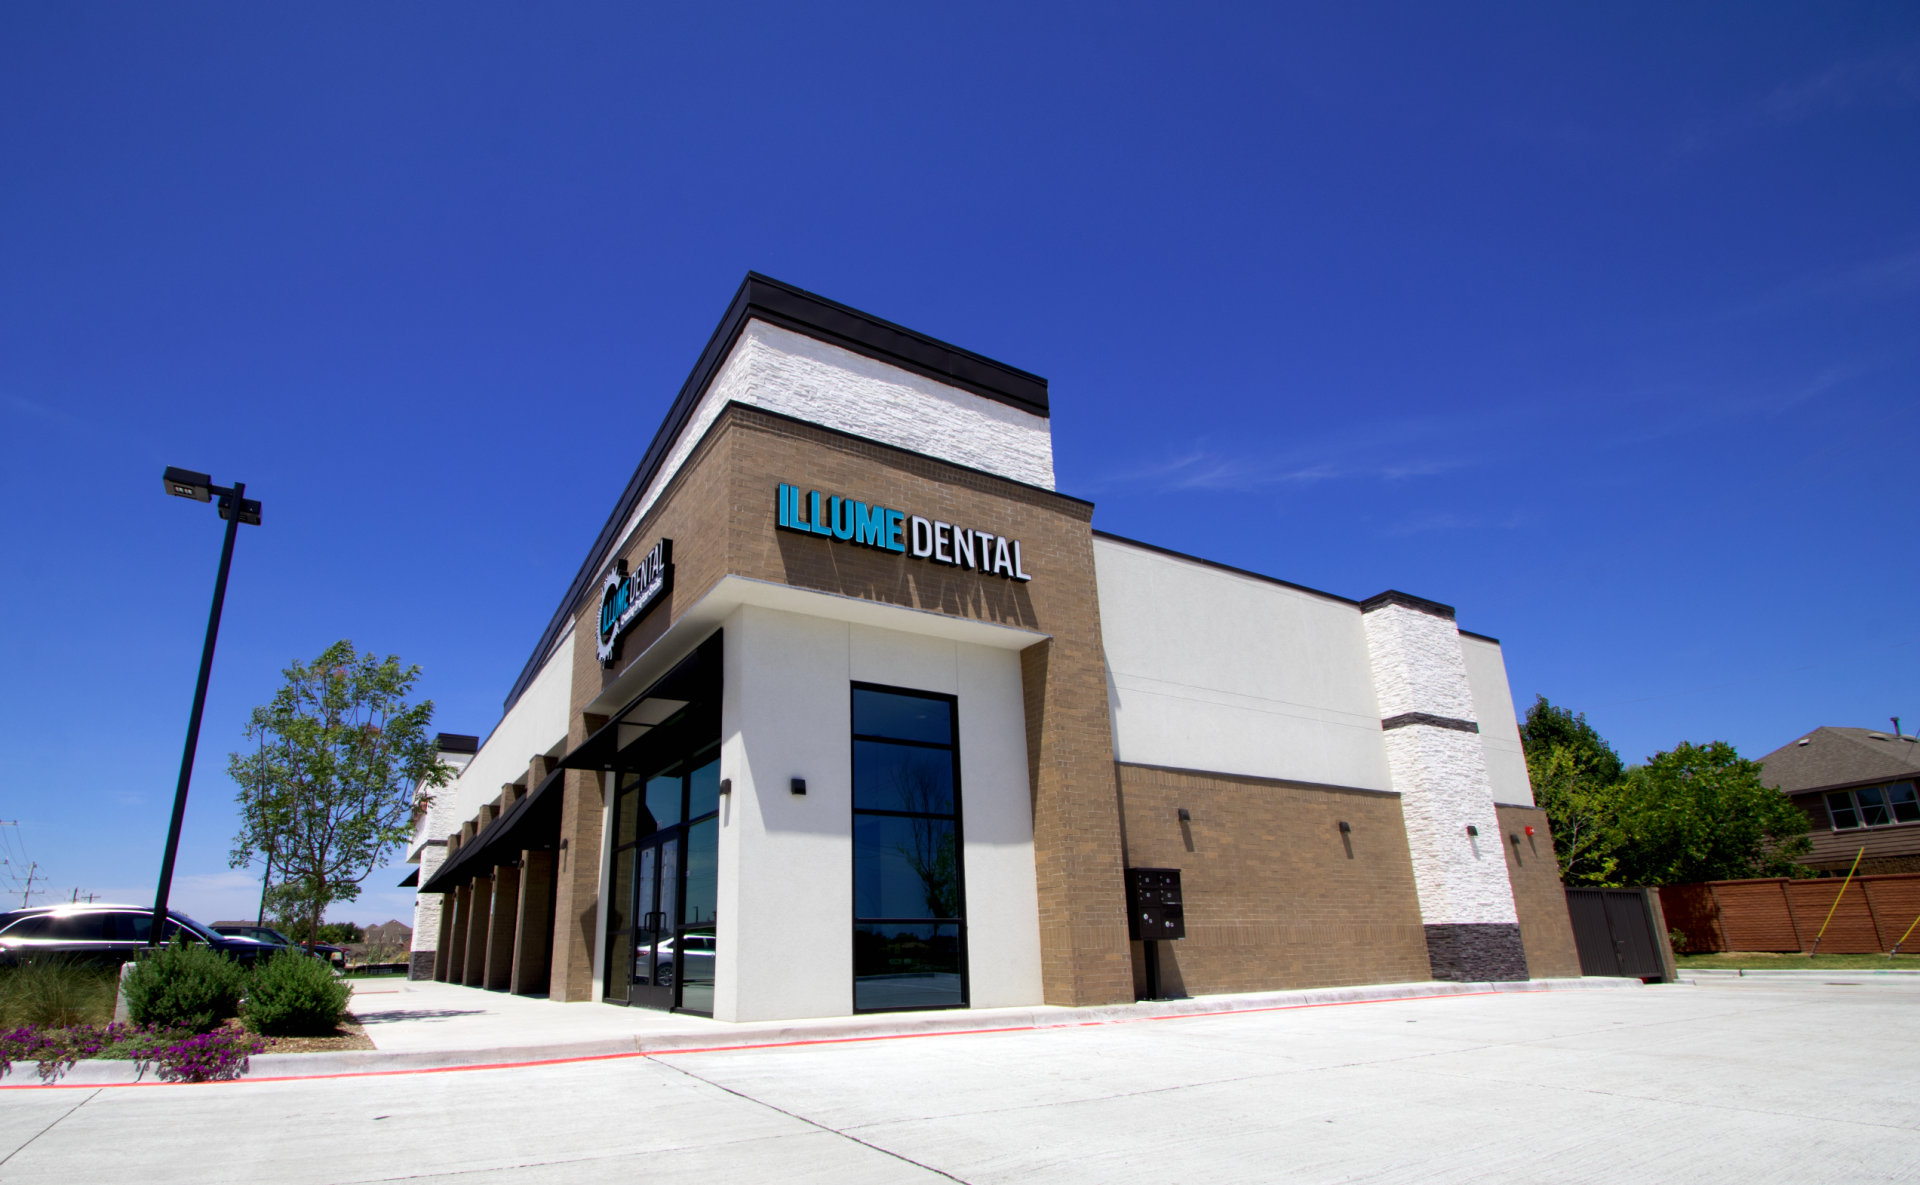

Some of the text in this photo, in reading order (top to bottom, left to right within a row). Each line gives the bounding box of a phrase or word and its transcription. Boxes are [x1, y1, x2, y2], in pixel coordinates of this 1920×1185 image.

[777, 482, 1032, 581] ILLUME DENTAL
[602, 578, 630, 634] ILLUME
[629, 538, 665, 604] DENTAL
